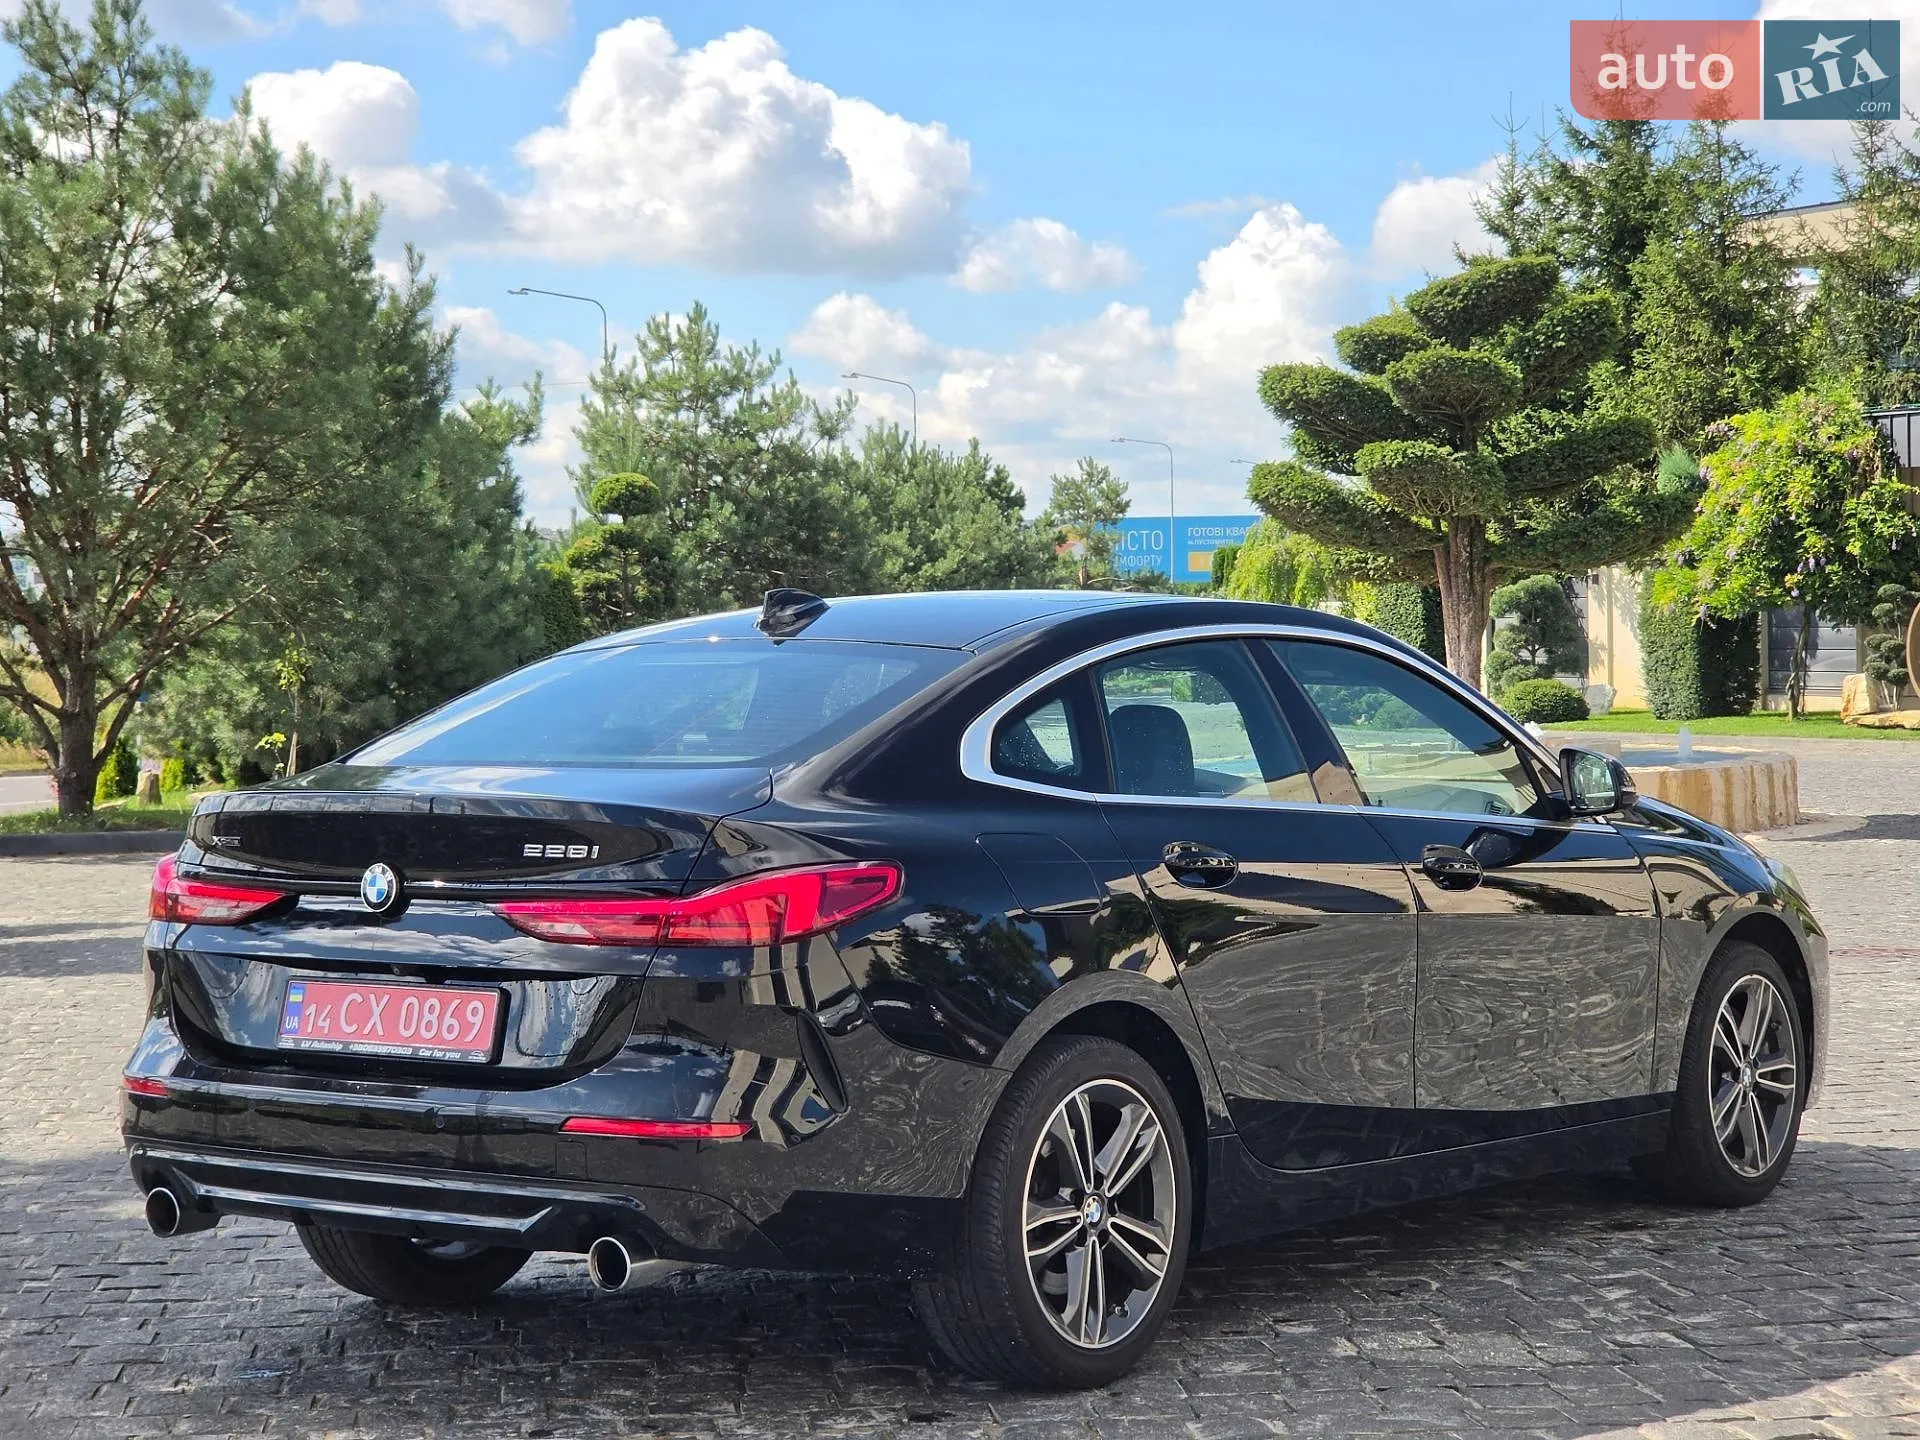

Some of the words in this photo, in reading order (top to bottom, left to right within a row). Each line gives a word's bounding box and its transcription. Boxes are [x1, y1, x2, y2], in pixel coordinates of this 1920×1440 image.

[1187, 527, 1224, 537] ГОТОВІ
[285, 1016, 299, 1029] UA
[304, 1003, 332, 1035] 14
[339, 992, 391, 1036] CX
[399, 996, 485, 1043] 0869
[418, 1048, 432, 1057] Car
[432, 1049, 445, 1058] for
